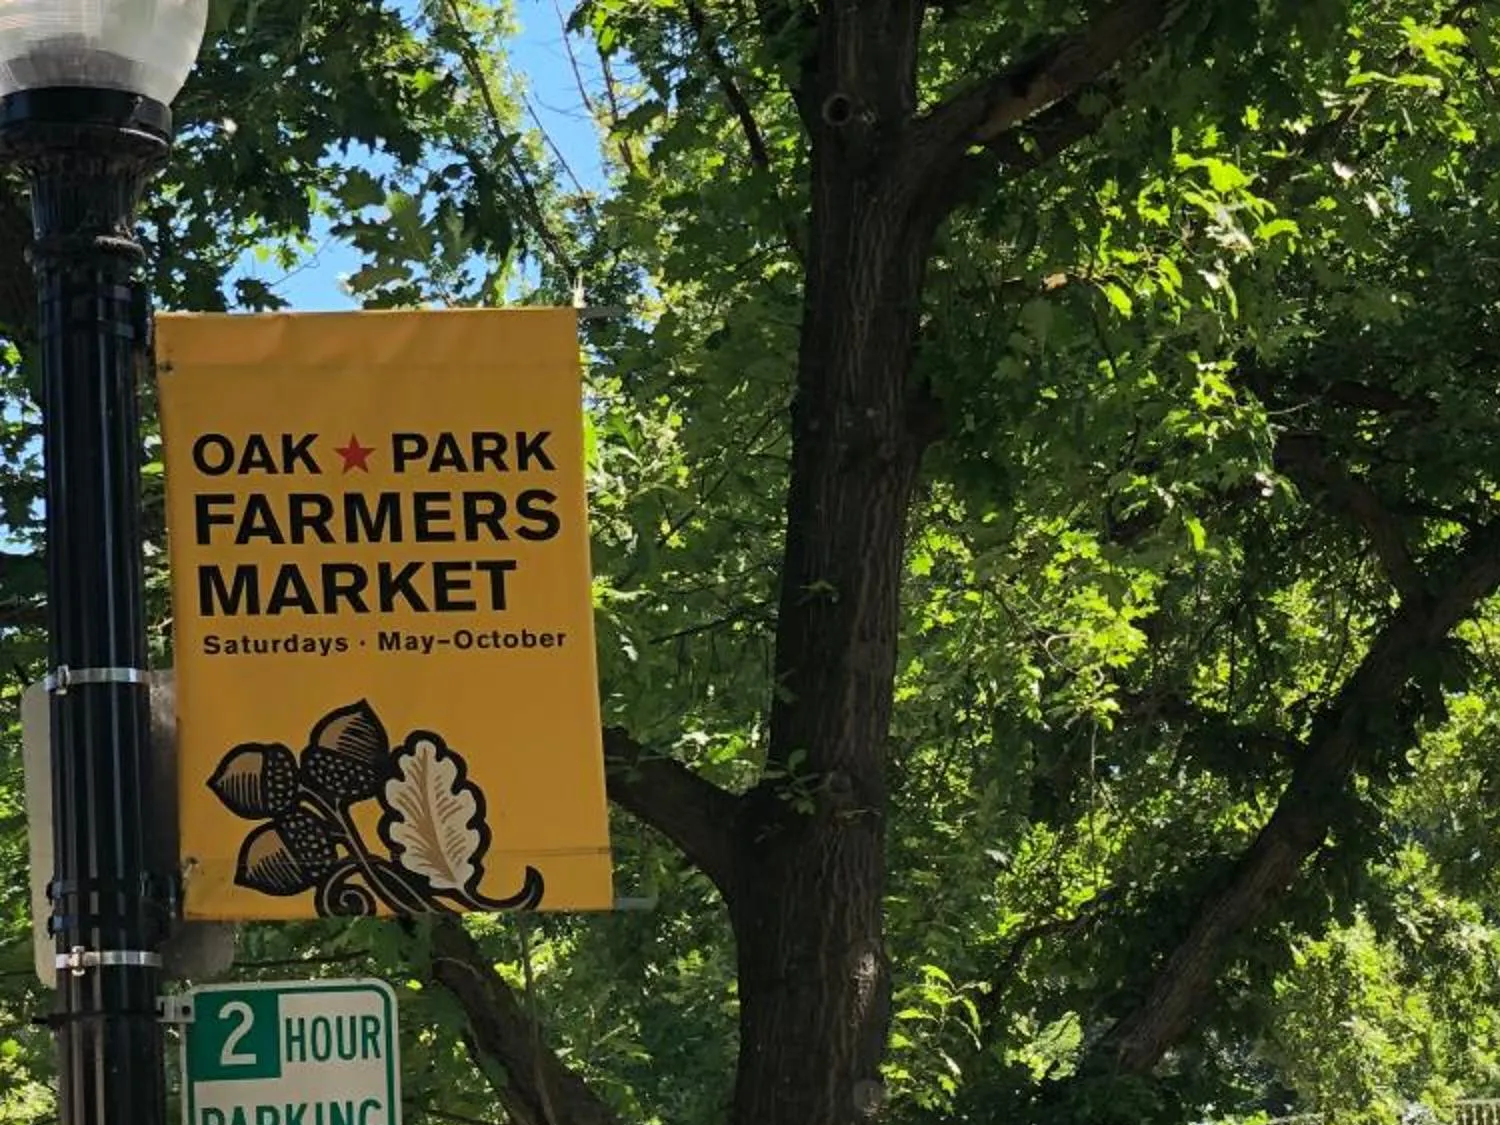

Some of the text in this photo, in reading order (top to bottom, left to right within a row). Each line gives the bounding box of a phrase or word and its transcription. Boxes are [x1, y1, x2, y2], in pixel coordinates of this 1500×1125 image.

[192, 430, 557, 477] OAK PARK
[195, 488, 562, 545] FARMERS
[197, 559, 517, 617] MARKET
[203, 633, 349, 656] Saturdays
[218, 1001, 381, 1066] 2 HOUR
